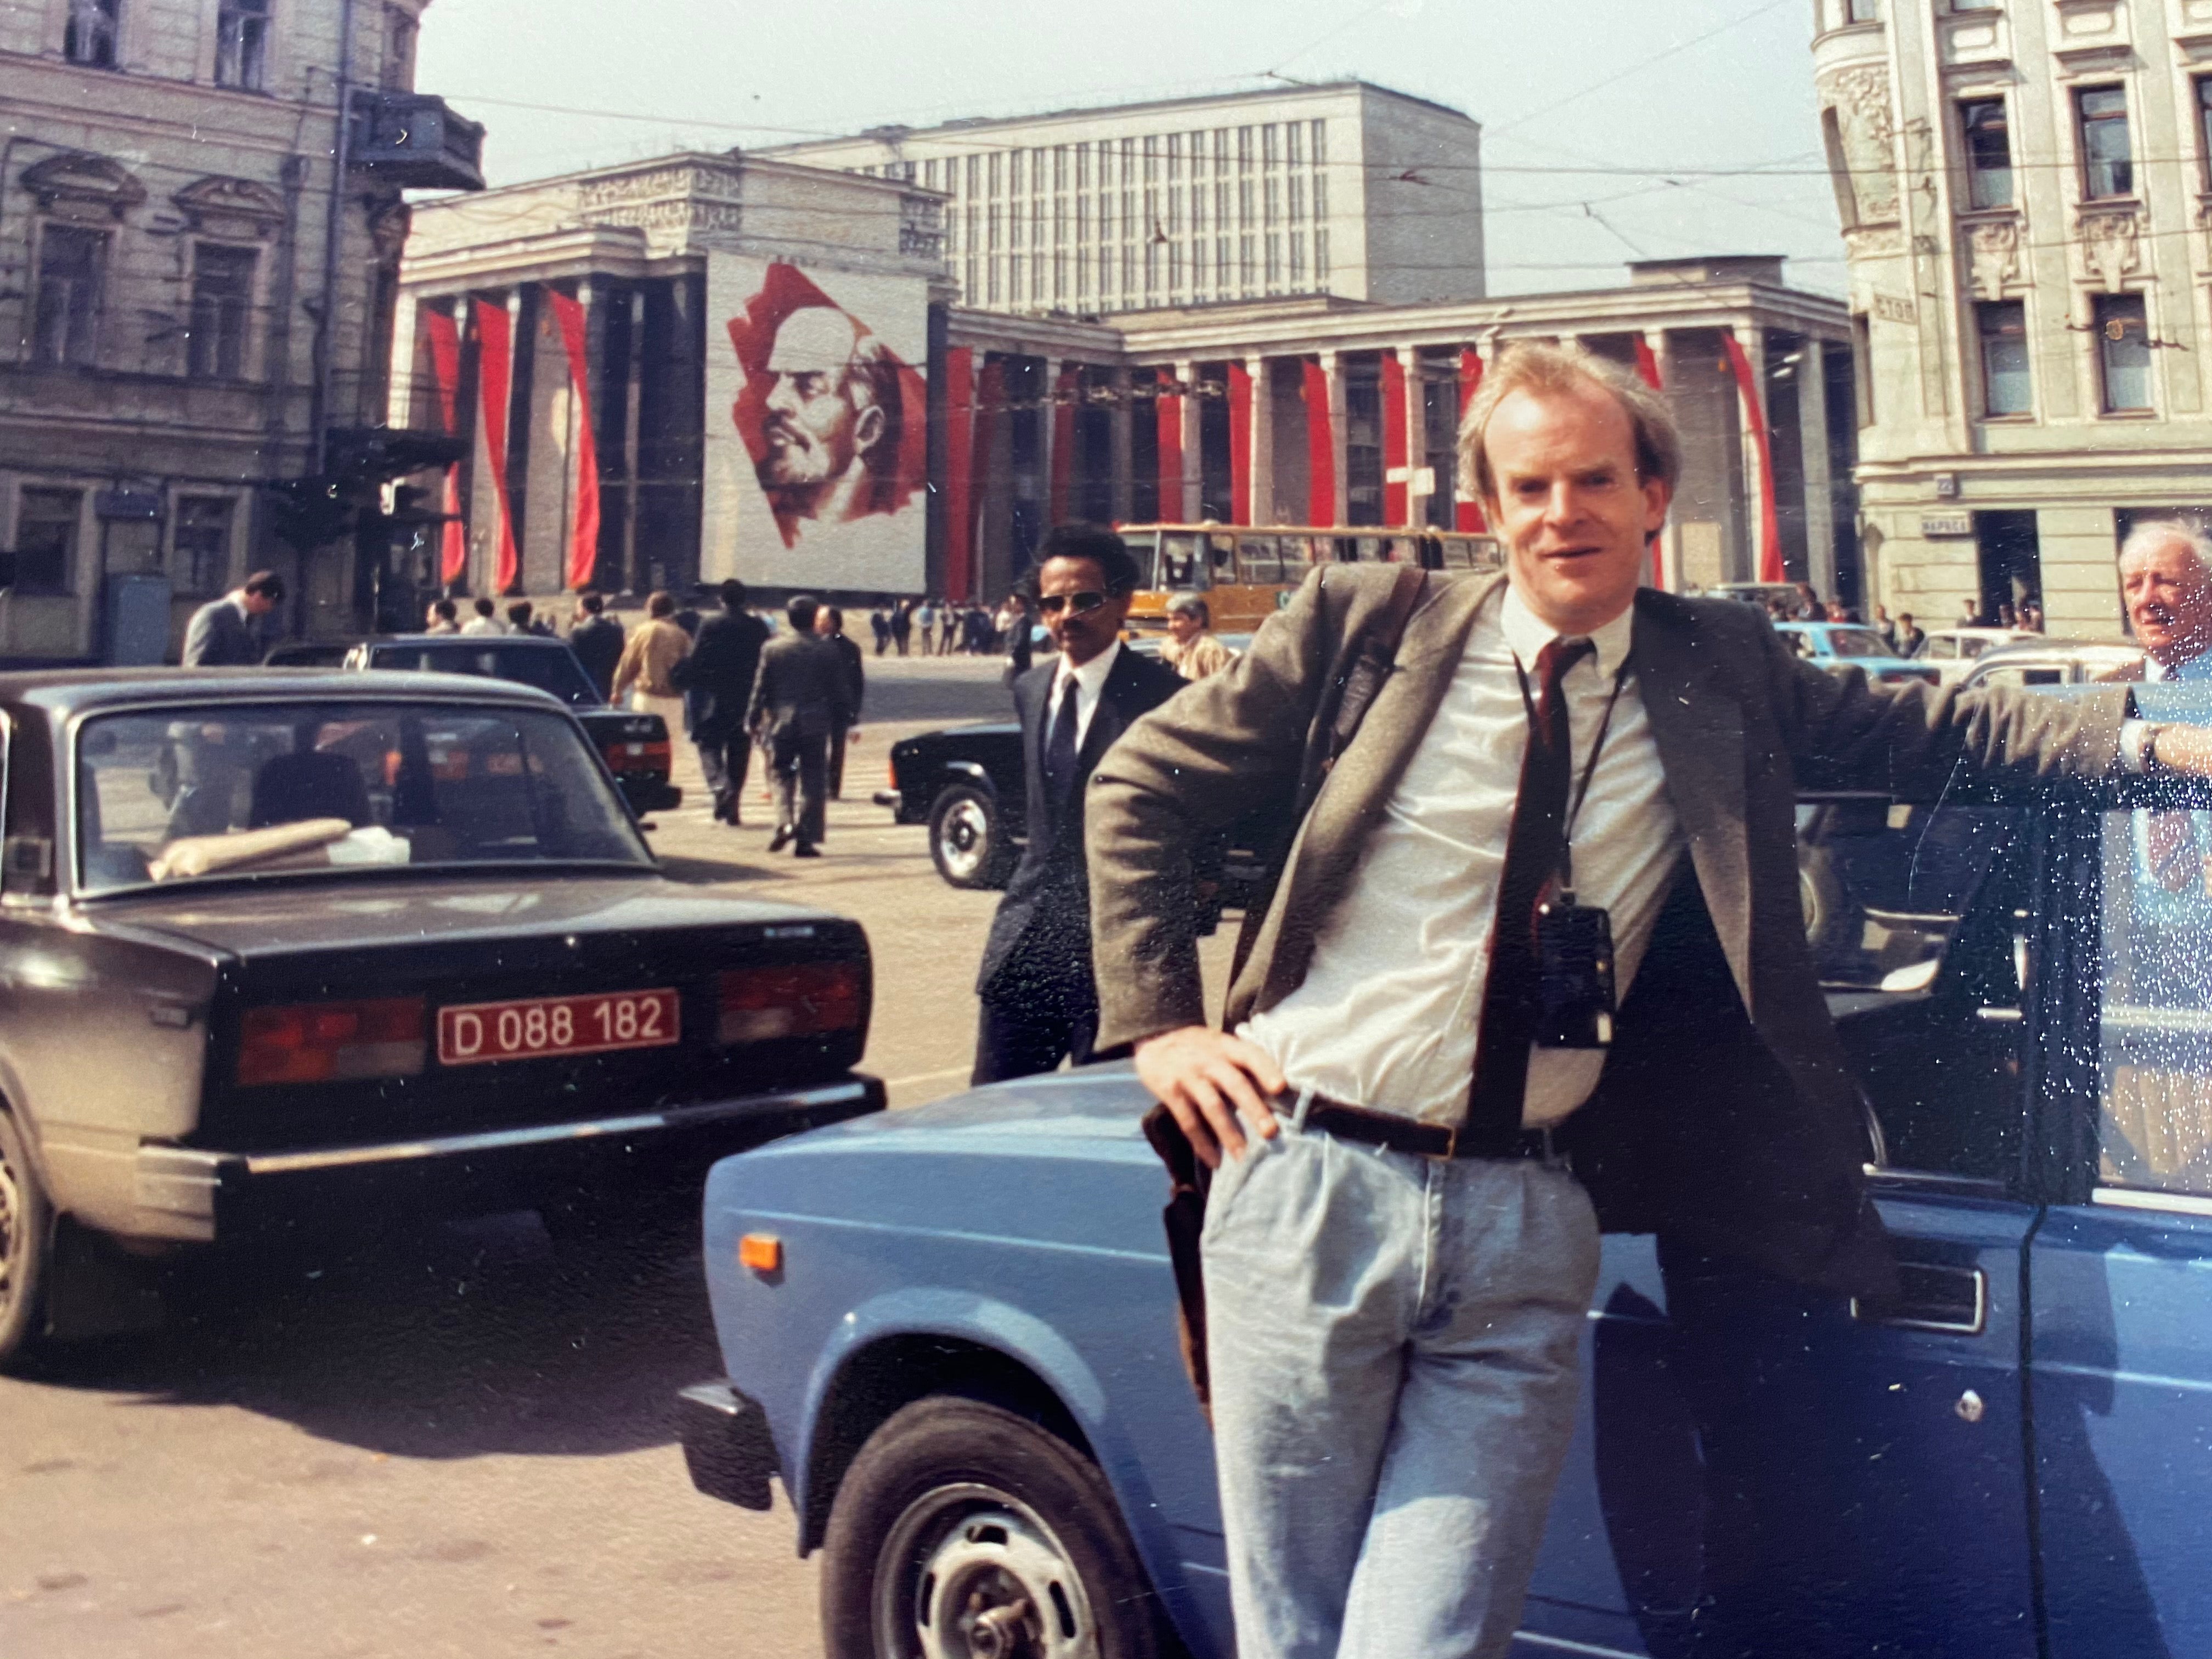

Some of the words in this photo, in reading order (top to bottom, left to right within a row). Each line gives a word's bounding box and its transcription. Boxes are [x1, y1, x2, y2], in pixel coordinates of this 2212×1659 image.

[454, 1013, 483, 1056] D
[498, 1005, 574, 1051] 088
[594, 997, 662, 1041] 182
